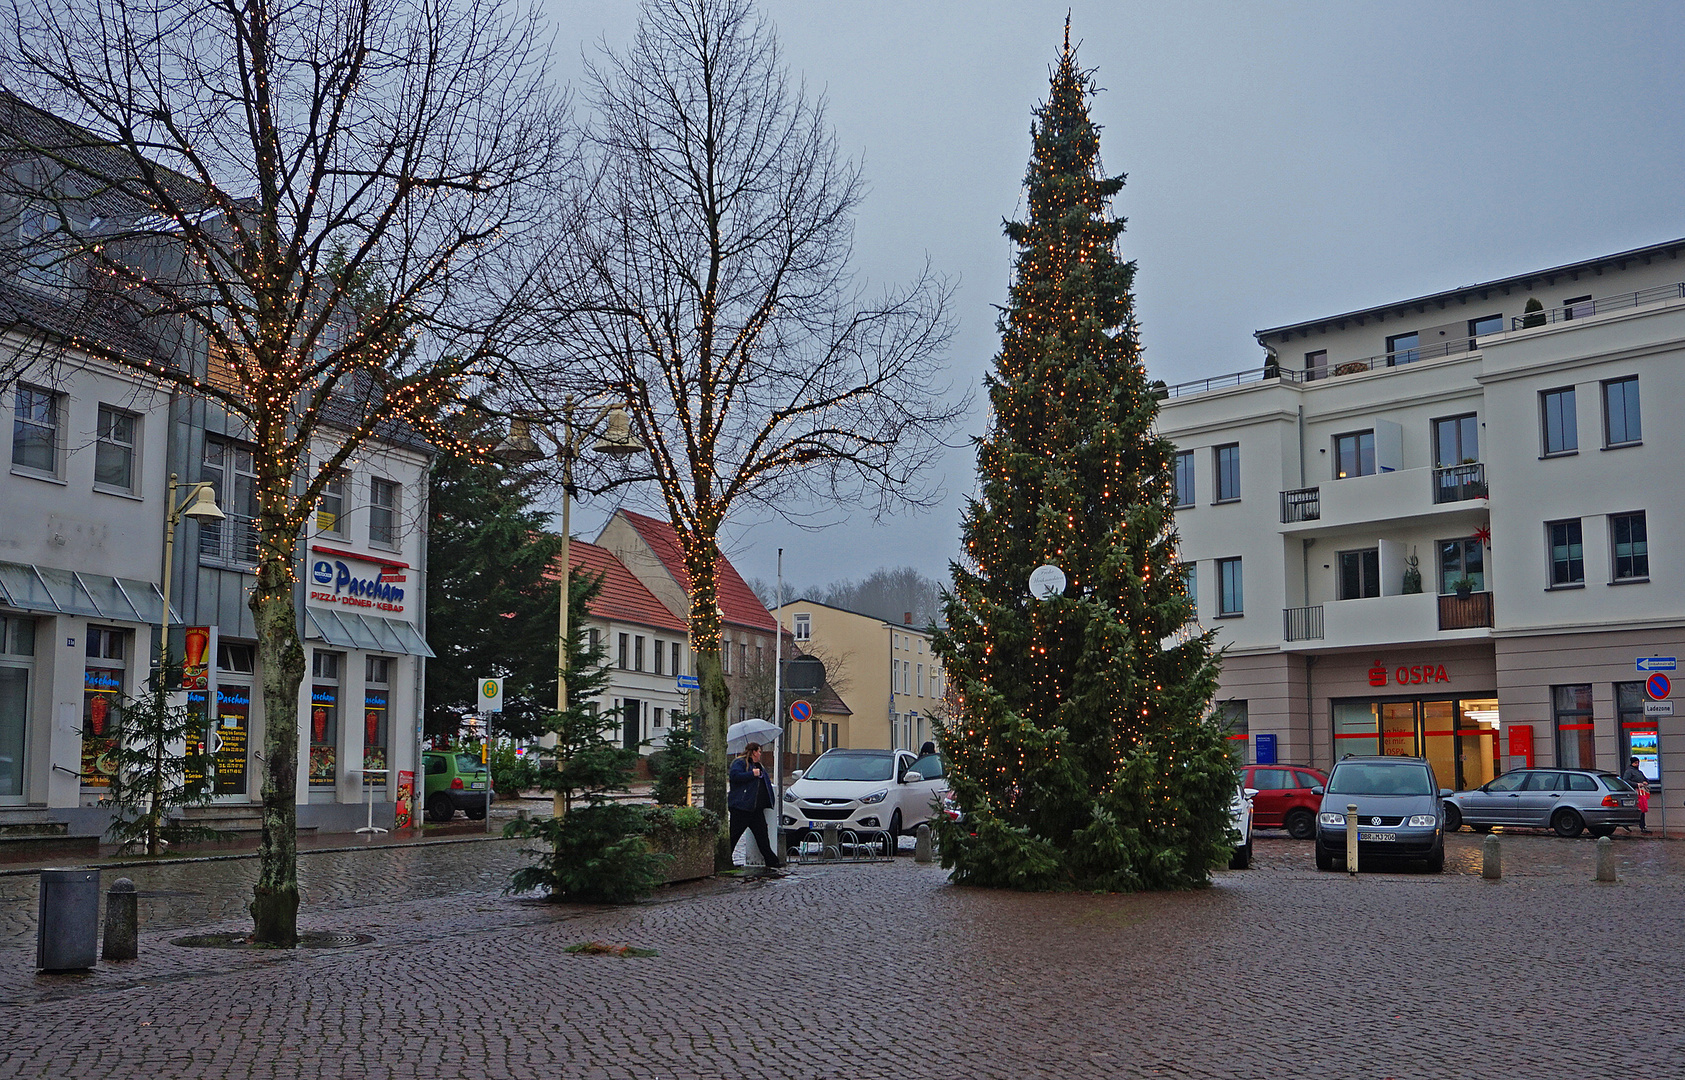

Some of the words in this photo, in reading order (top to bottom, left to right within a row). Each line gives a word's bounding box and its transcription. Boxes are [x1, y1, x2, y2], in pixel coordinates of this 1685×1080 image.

[335, 560, 404, 602] Pascham
[311, 592, 336, 602] PIZZA
[342, 595, 372, 608] DÖNER
[377, 602, 404, 612] KEBAP
[1395, 665, 1450, 684] OSPA
[217, 691, 250, 705] Pascham
[1386, 748, 1405, 756] OSPA
